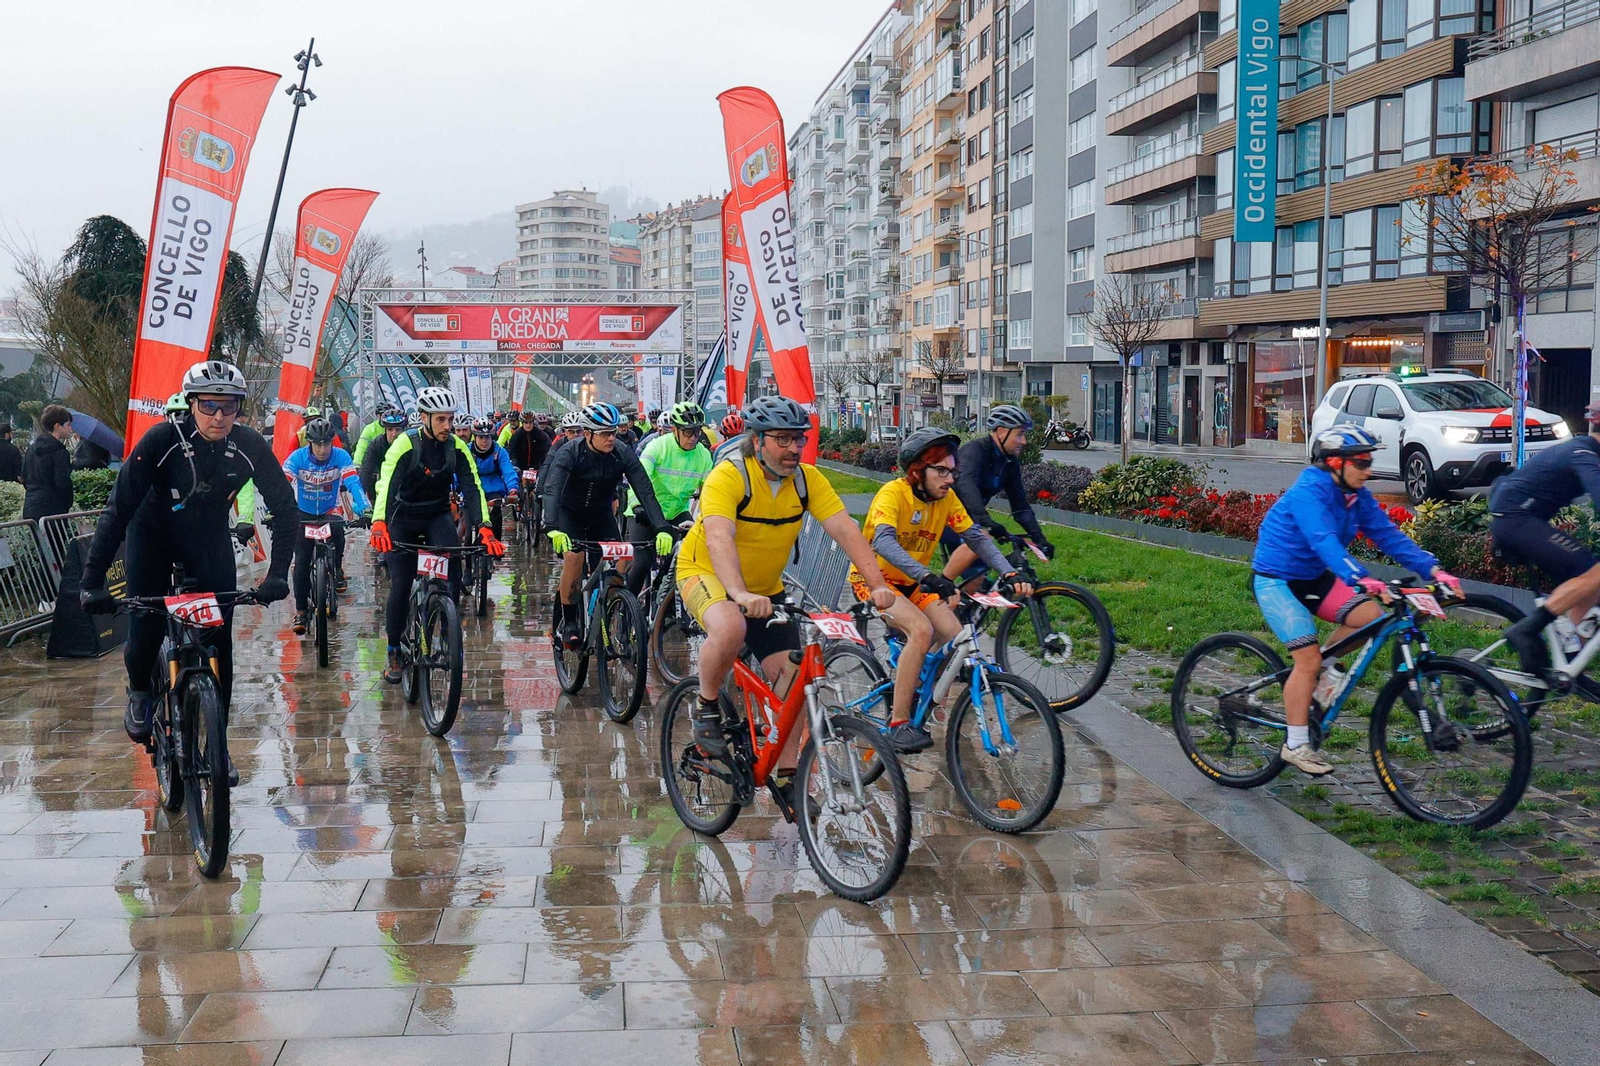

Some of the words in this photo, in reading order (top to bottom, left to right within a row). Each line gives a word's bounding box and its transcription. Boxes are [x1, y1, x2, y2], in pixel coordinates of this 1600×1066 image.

[1246, 18, 1274, 76] Vigo
[1244, 84, 1268, 223] Occidental
[149, 195, 191, 328] CONCELLO
[182, 218, 212, 276] VIGO
[173, 285, 198, 320] DE
[283, 267, 310, 354] CONCELLO
[491, 308, 502, 323] A
[508, 307, 555, 323] GRAN
[731, 283, 748, 322] VIGO
[491, 323, 568, 339] BIKEDADA
[176, 602, 213, 624] 314
[823, 621, 857, 638] 321
